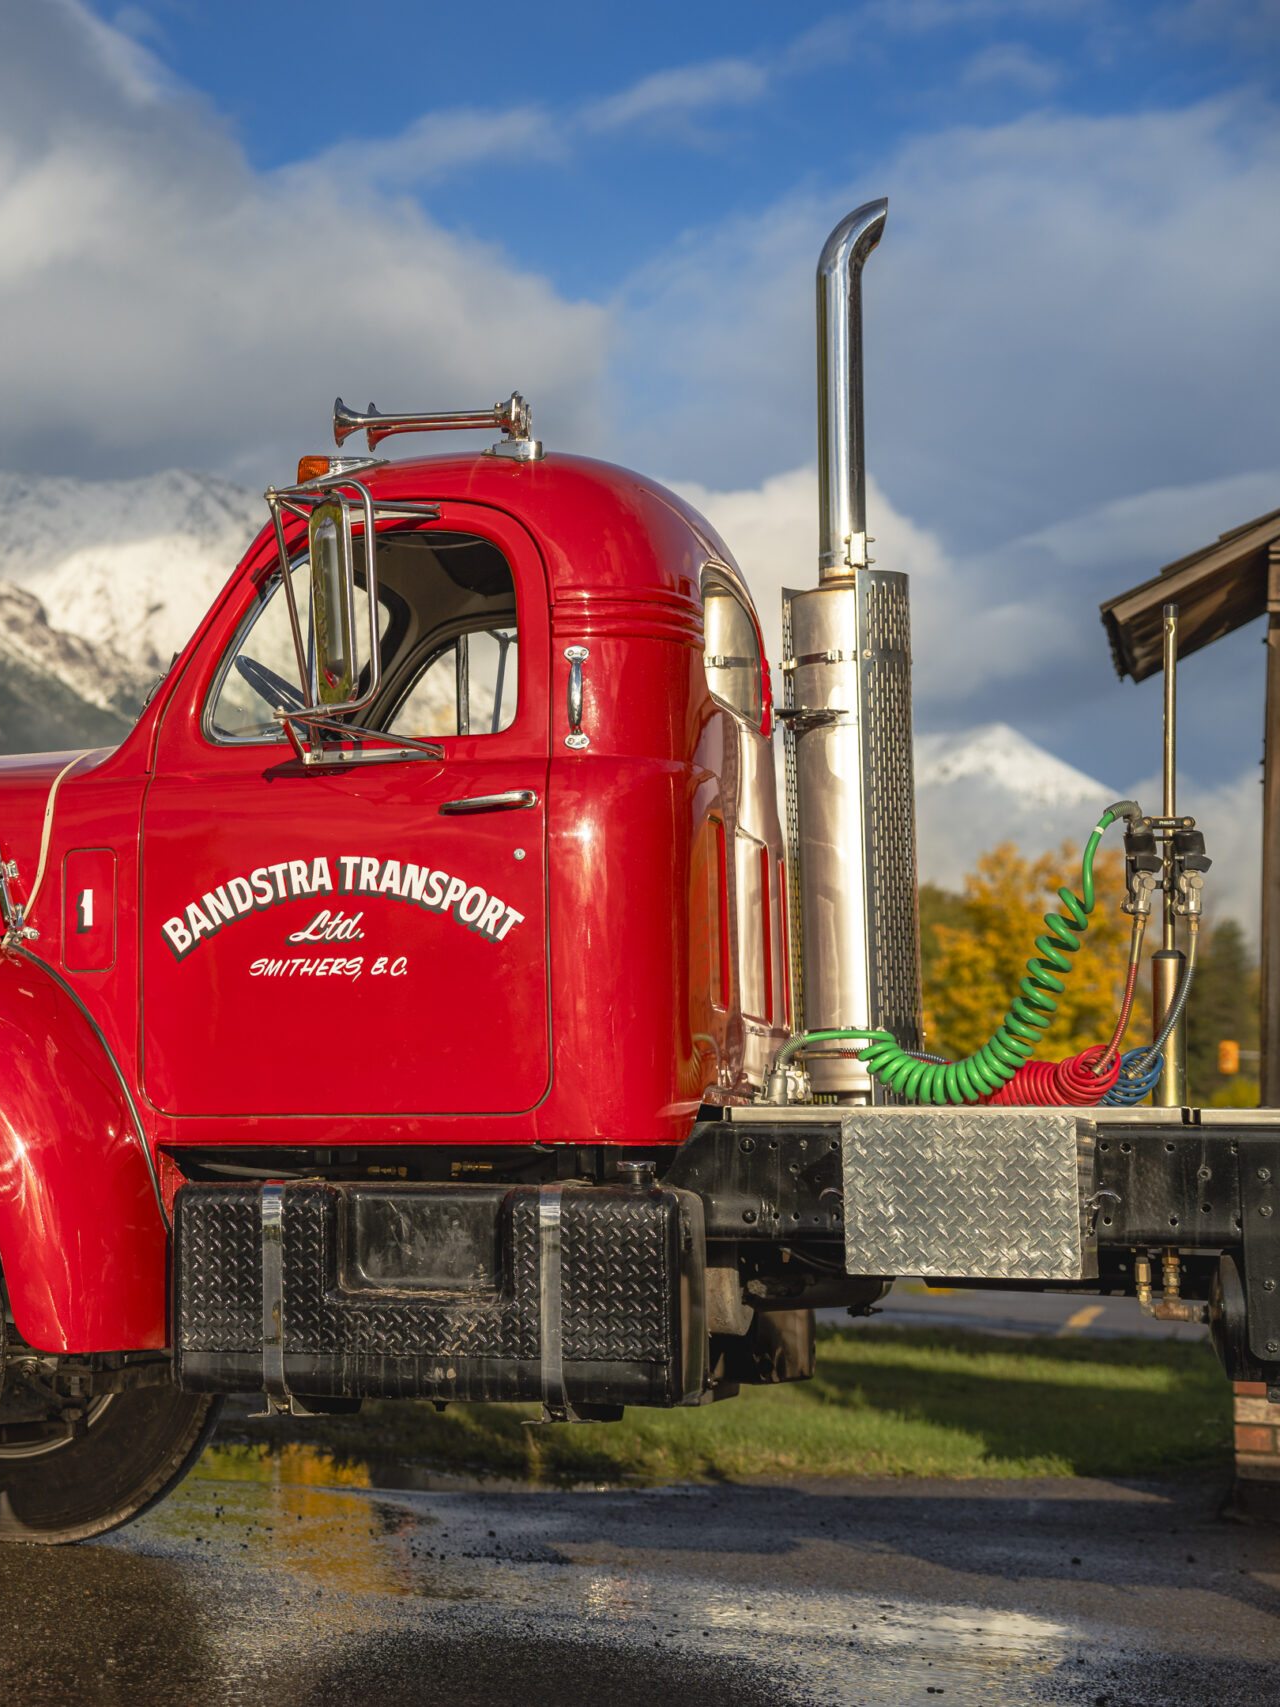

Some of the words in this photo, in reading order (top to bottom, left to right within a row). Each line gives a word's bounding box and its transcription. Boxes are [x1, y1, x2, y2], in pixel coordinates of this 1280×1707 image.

[79, 888, 93, 927] 1
[162, 856, 333, 956] BANDSTRA
[338, 855, 526, 942] TRANSPORT
[288, 909, 366, 943] Ltd.
[249, 956, 365, 982] SMITHERS,
[370, 956, 408, 976] B.C.
